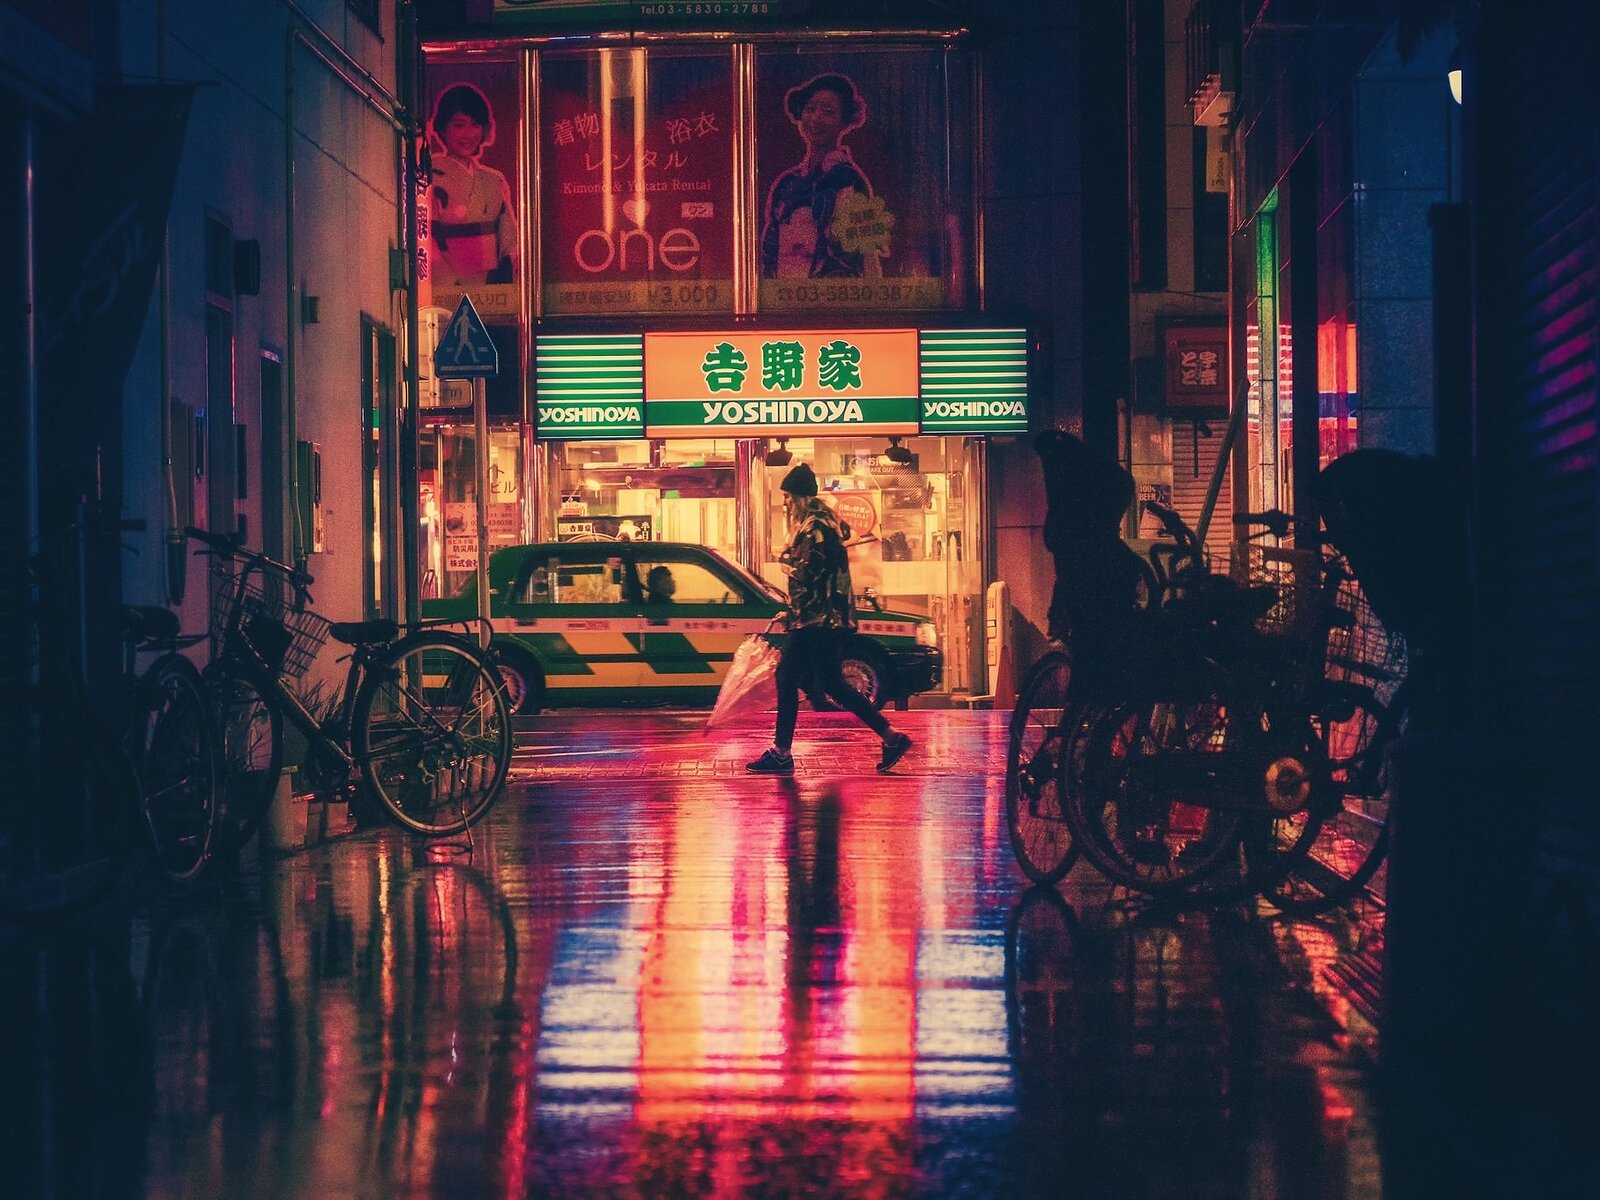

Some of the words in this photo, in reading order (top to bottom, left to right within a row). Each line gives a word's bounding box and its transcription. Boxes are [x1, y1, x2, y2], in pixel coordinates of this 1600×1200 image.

[640, 5, 768, 15] Tel.03-5830-2788
[554, 113, 600, 146] 着物
[666, 112, 719, 145] 浴衣
[627, 180, 667, 192] Ykata
[671, 179, 710, 191] Rental
[574, 228, 701, 273] one
[540, 407, 641, 422] YOSHINOYA
[703, 400, 864, 424] YOSHINOYA
[925, 401, 1026, 418] YOSHINOYA
